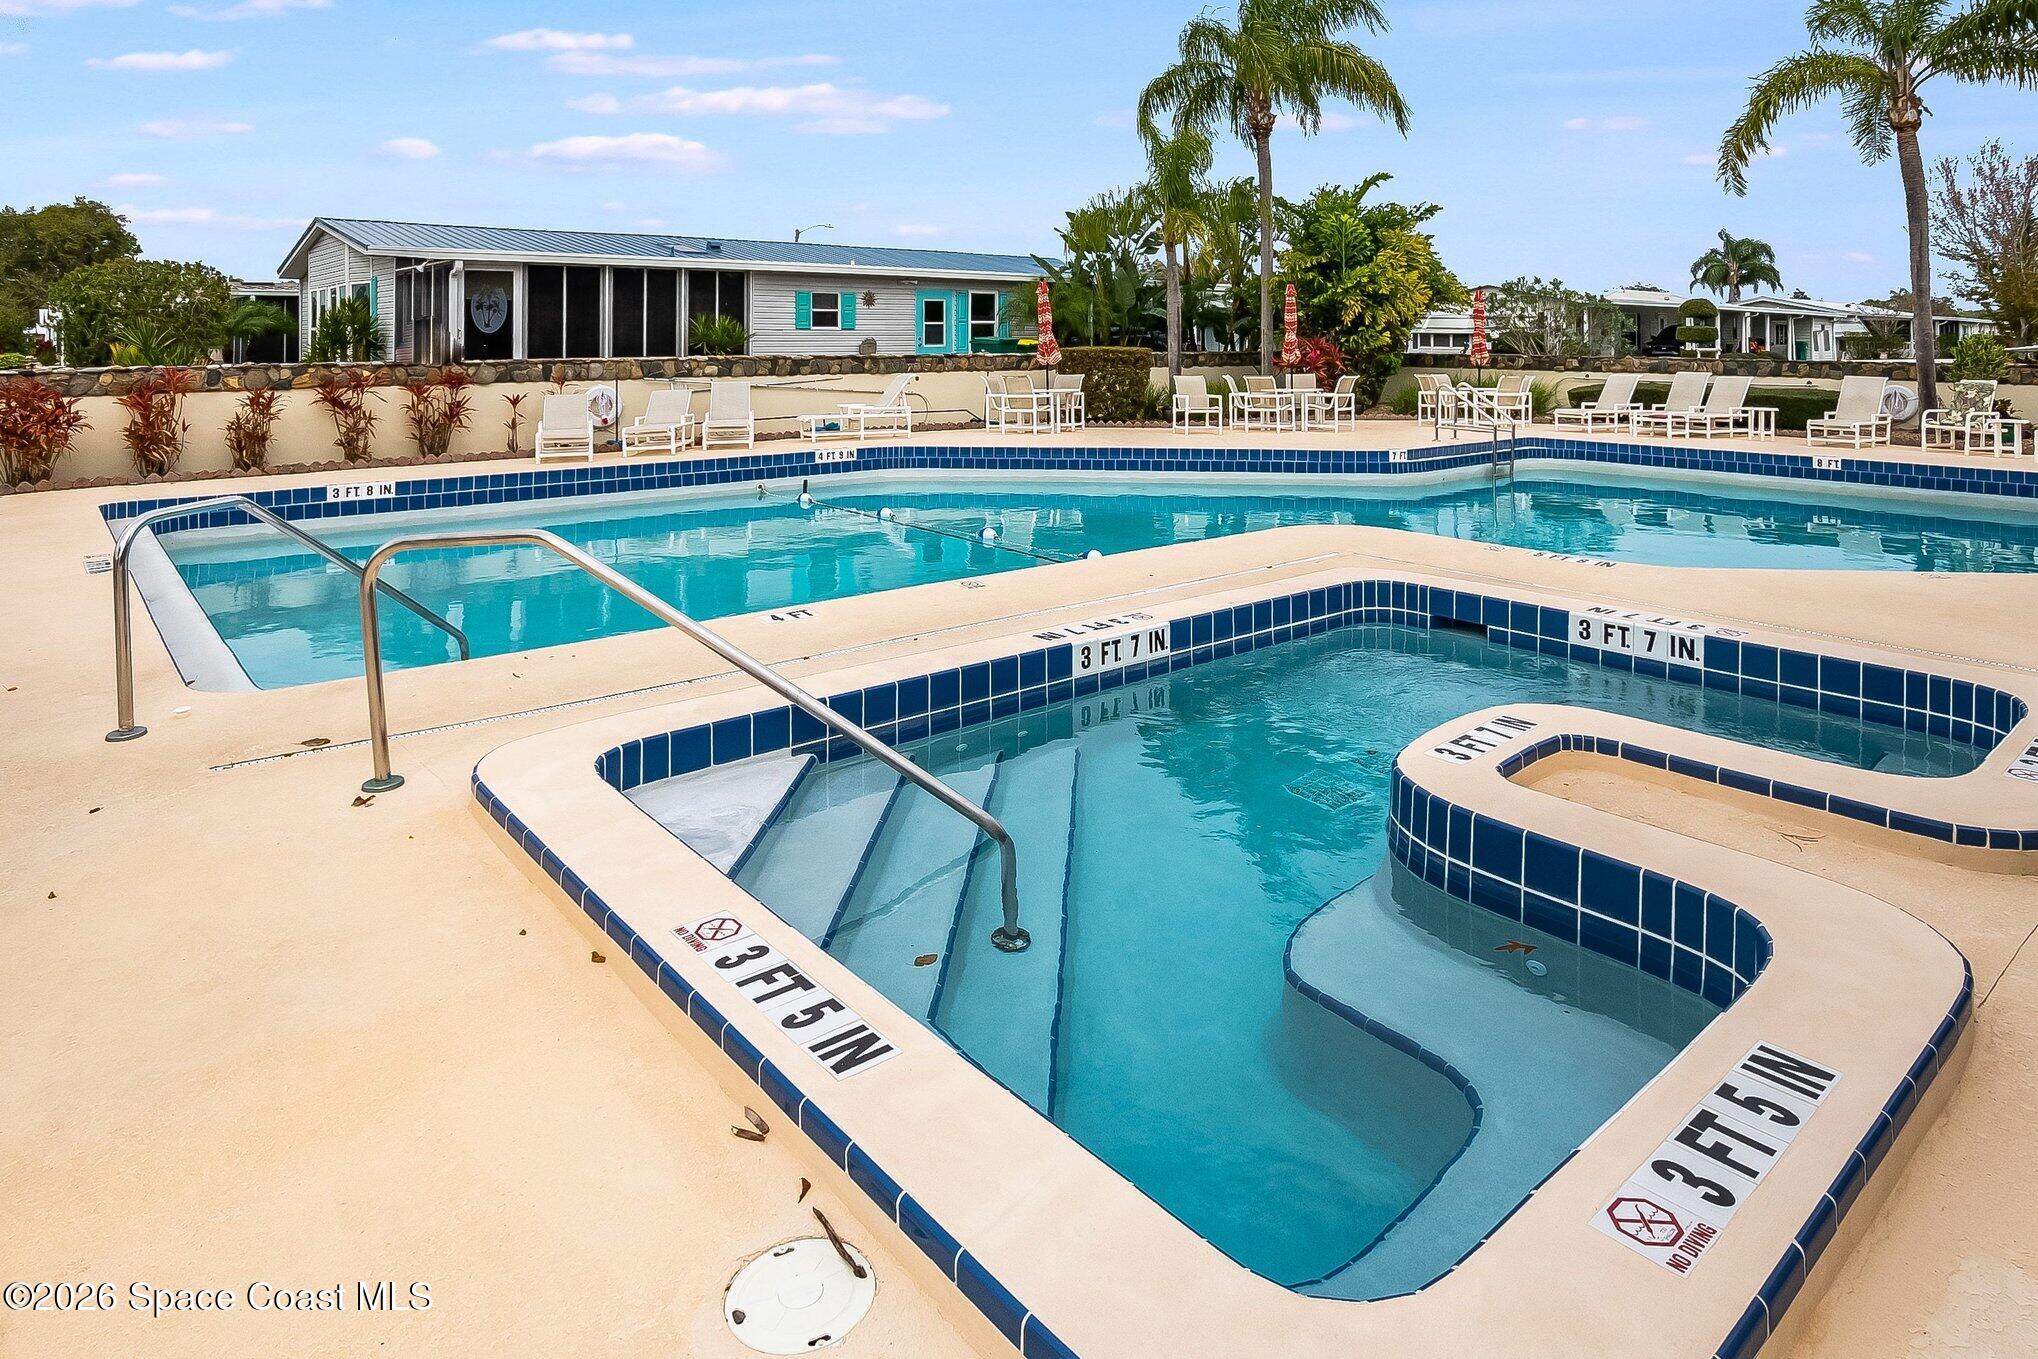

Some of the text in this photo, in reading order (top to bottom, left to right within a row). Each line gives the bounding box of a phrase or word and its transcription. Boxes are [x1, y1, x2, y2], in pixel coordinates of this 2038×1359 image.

[1817, 458, 1823, 467] 8
[332, 488, 340, 498] 3
[366, 485, 373, 495] 8
[786, 609, 814, 619] FT
[1586, 606, 1617, 615] IN
[1081, 621, 1113, 631] FT
[1646, 617, 1682, 626] FT
[1032, 631, 1067, 641] IN
[1578, 619, 1700, 662] 3 FT. 7 IN.
[1081, 628, 1168, 669] 3 FT. 7 IN.
[1434, 715, 1538, 760] 3 FT 7 IN
[673, 926, 708, 952] NO DIVING
[714, 945, 894, 1075] 3 FT 5 IN
[1650, 1044, 1836, 1208] 3 FT 5 IN
[1677, 1222, 1718, 1259] DIVING
[1665, 1253, 1692, 1274] NO
